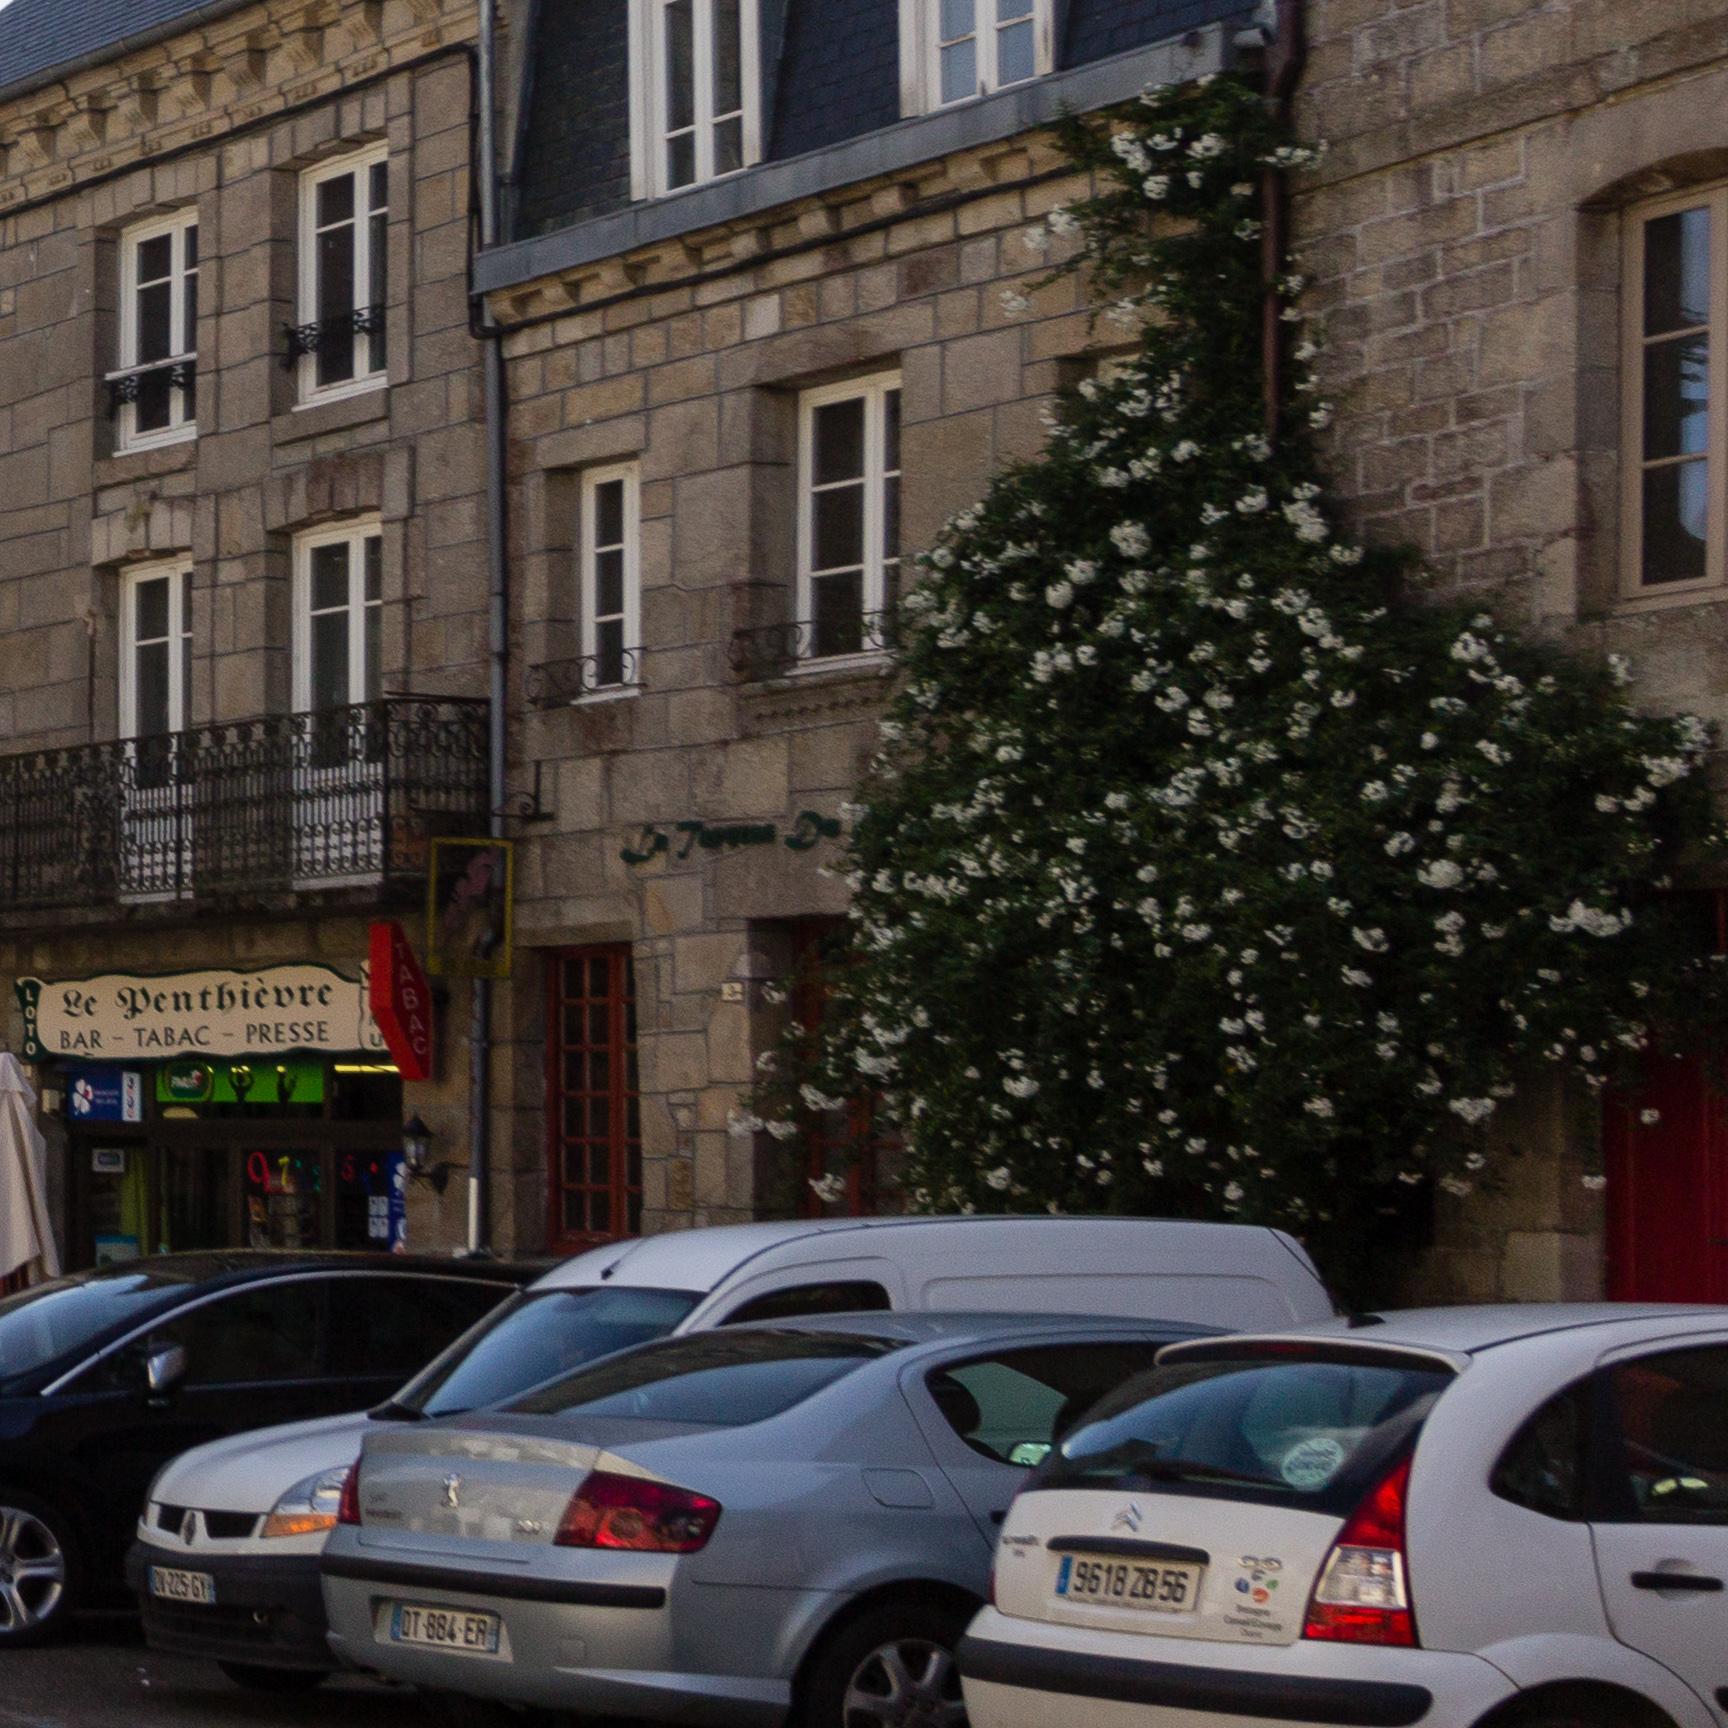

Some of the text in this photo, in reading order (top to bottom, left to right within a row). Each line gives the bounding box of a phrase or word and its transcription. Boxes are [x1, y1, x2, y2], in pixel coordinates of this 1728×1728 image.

[24, 989, 37, 1055] LOTO
[62, 977, 333, 1020] Le Penthièvre
[396, 943, 427, 1054] TABAC
[60, 1029, 102, 1049] BAR
[134, 1025, 210, 1047] TABAC
[246, 1021, 330, 1044] PRESSE
